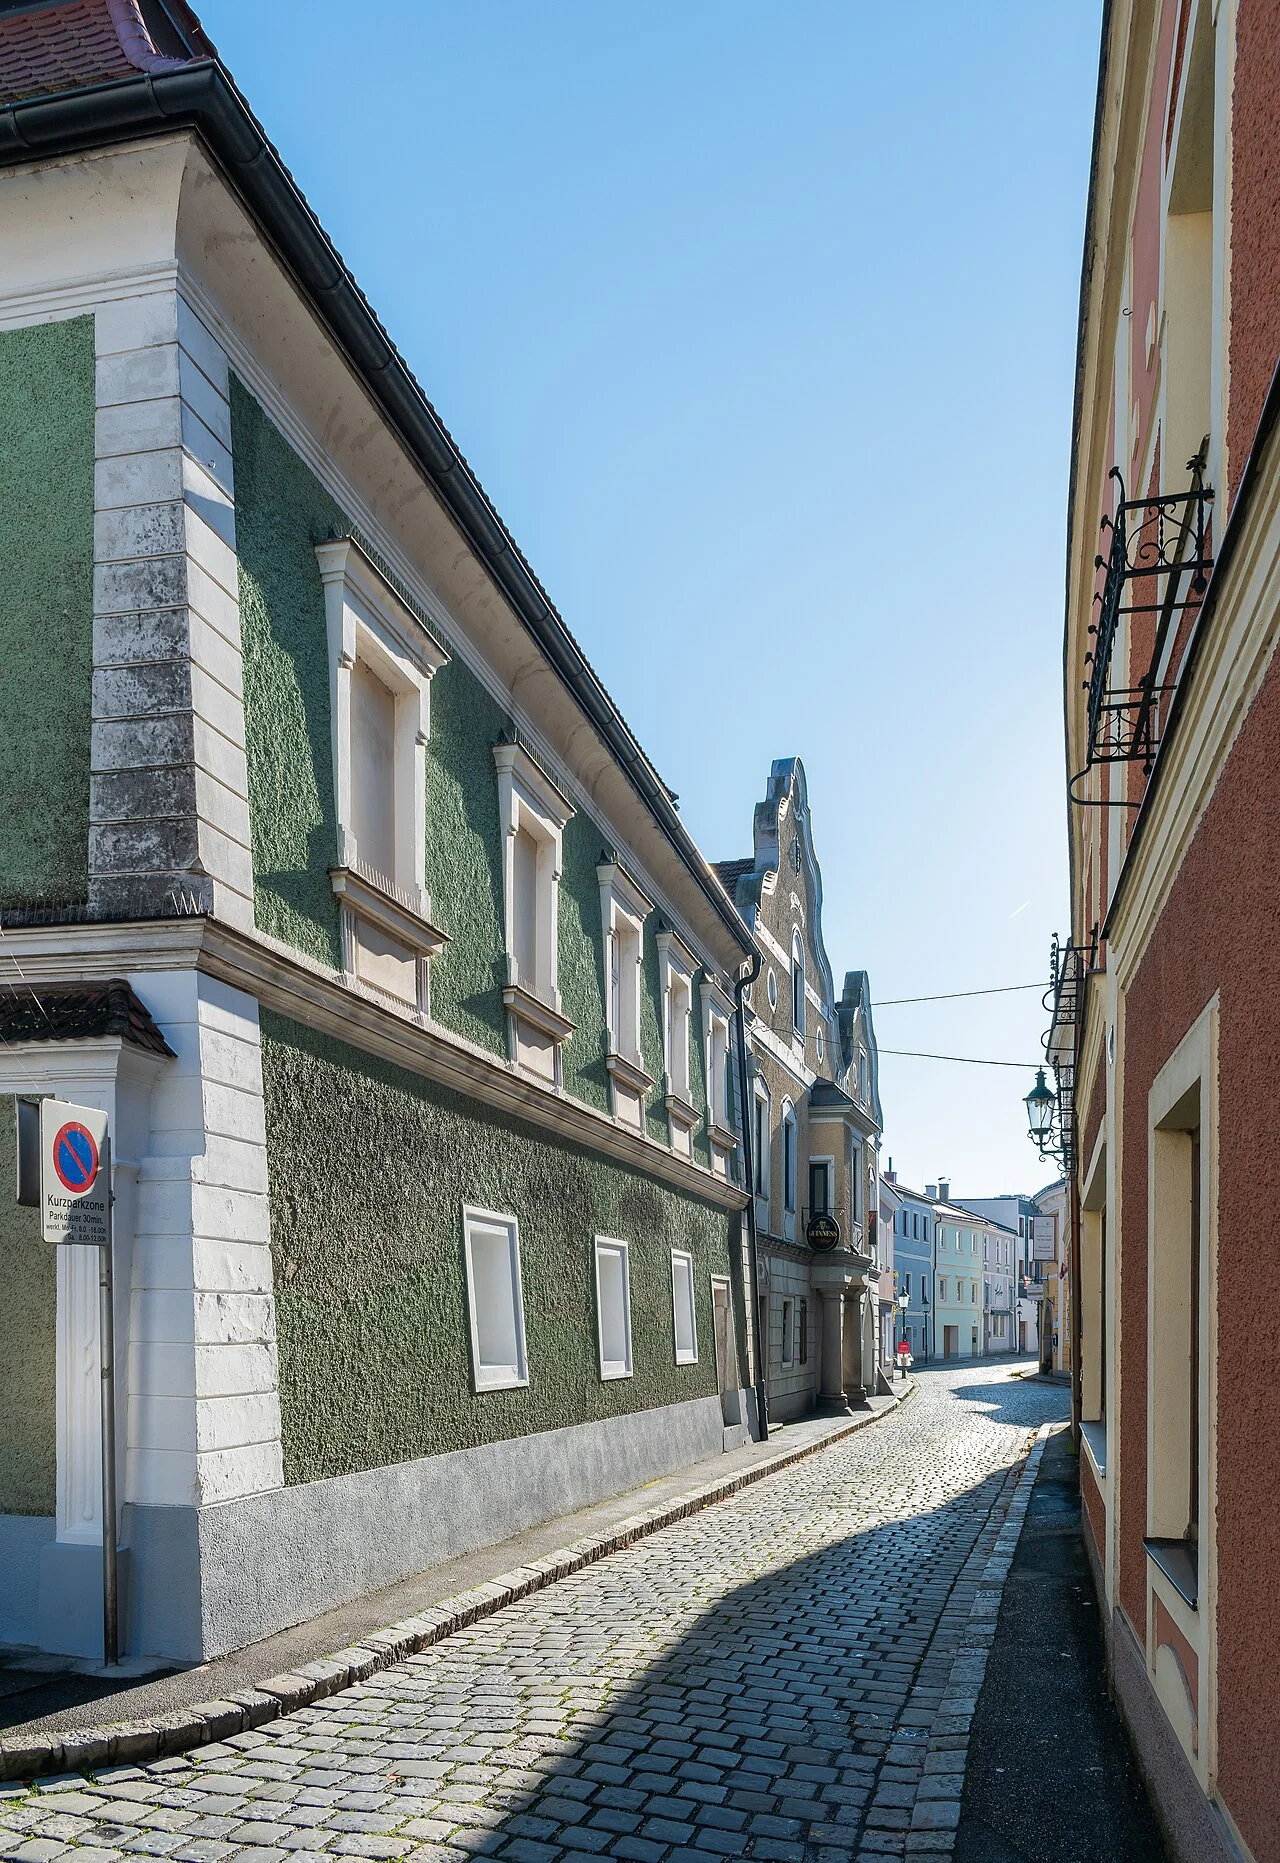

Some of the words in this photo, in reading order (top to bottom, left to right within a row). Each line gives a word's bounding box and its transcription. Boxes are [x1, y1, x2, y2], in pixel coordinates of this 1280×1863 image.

[47, 1194, 105, 1211] Kurzparkzone
[49, 1210, 82, 1222] Parkdauer
[82, 1214, 103, 1225] 30min.
